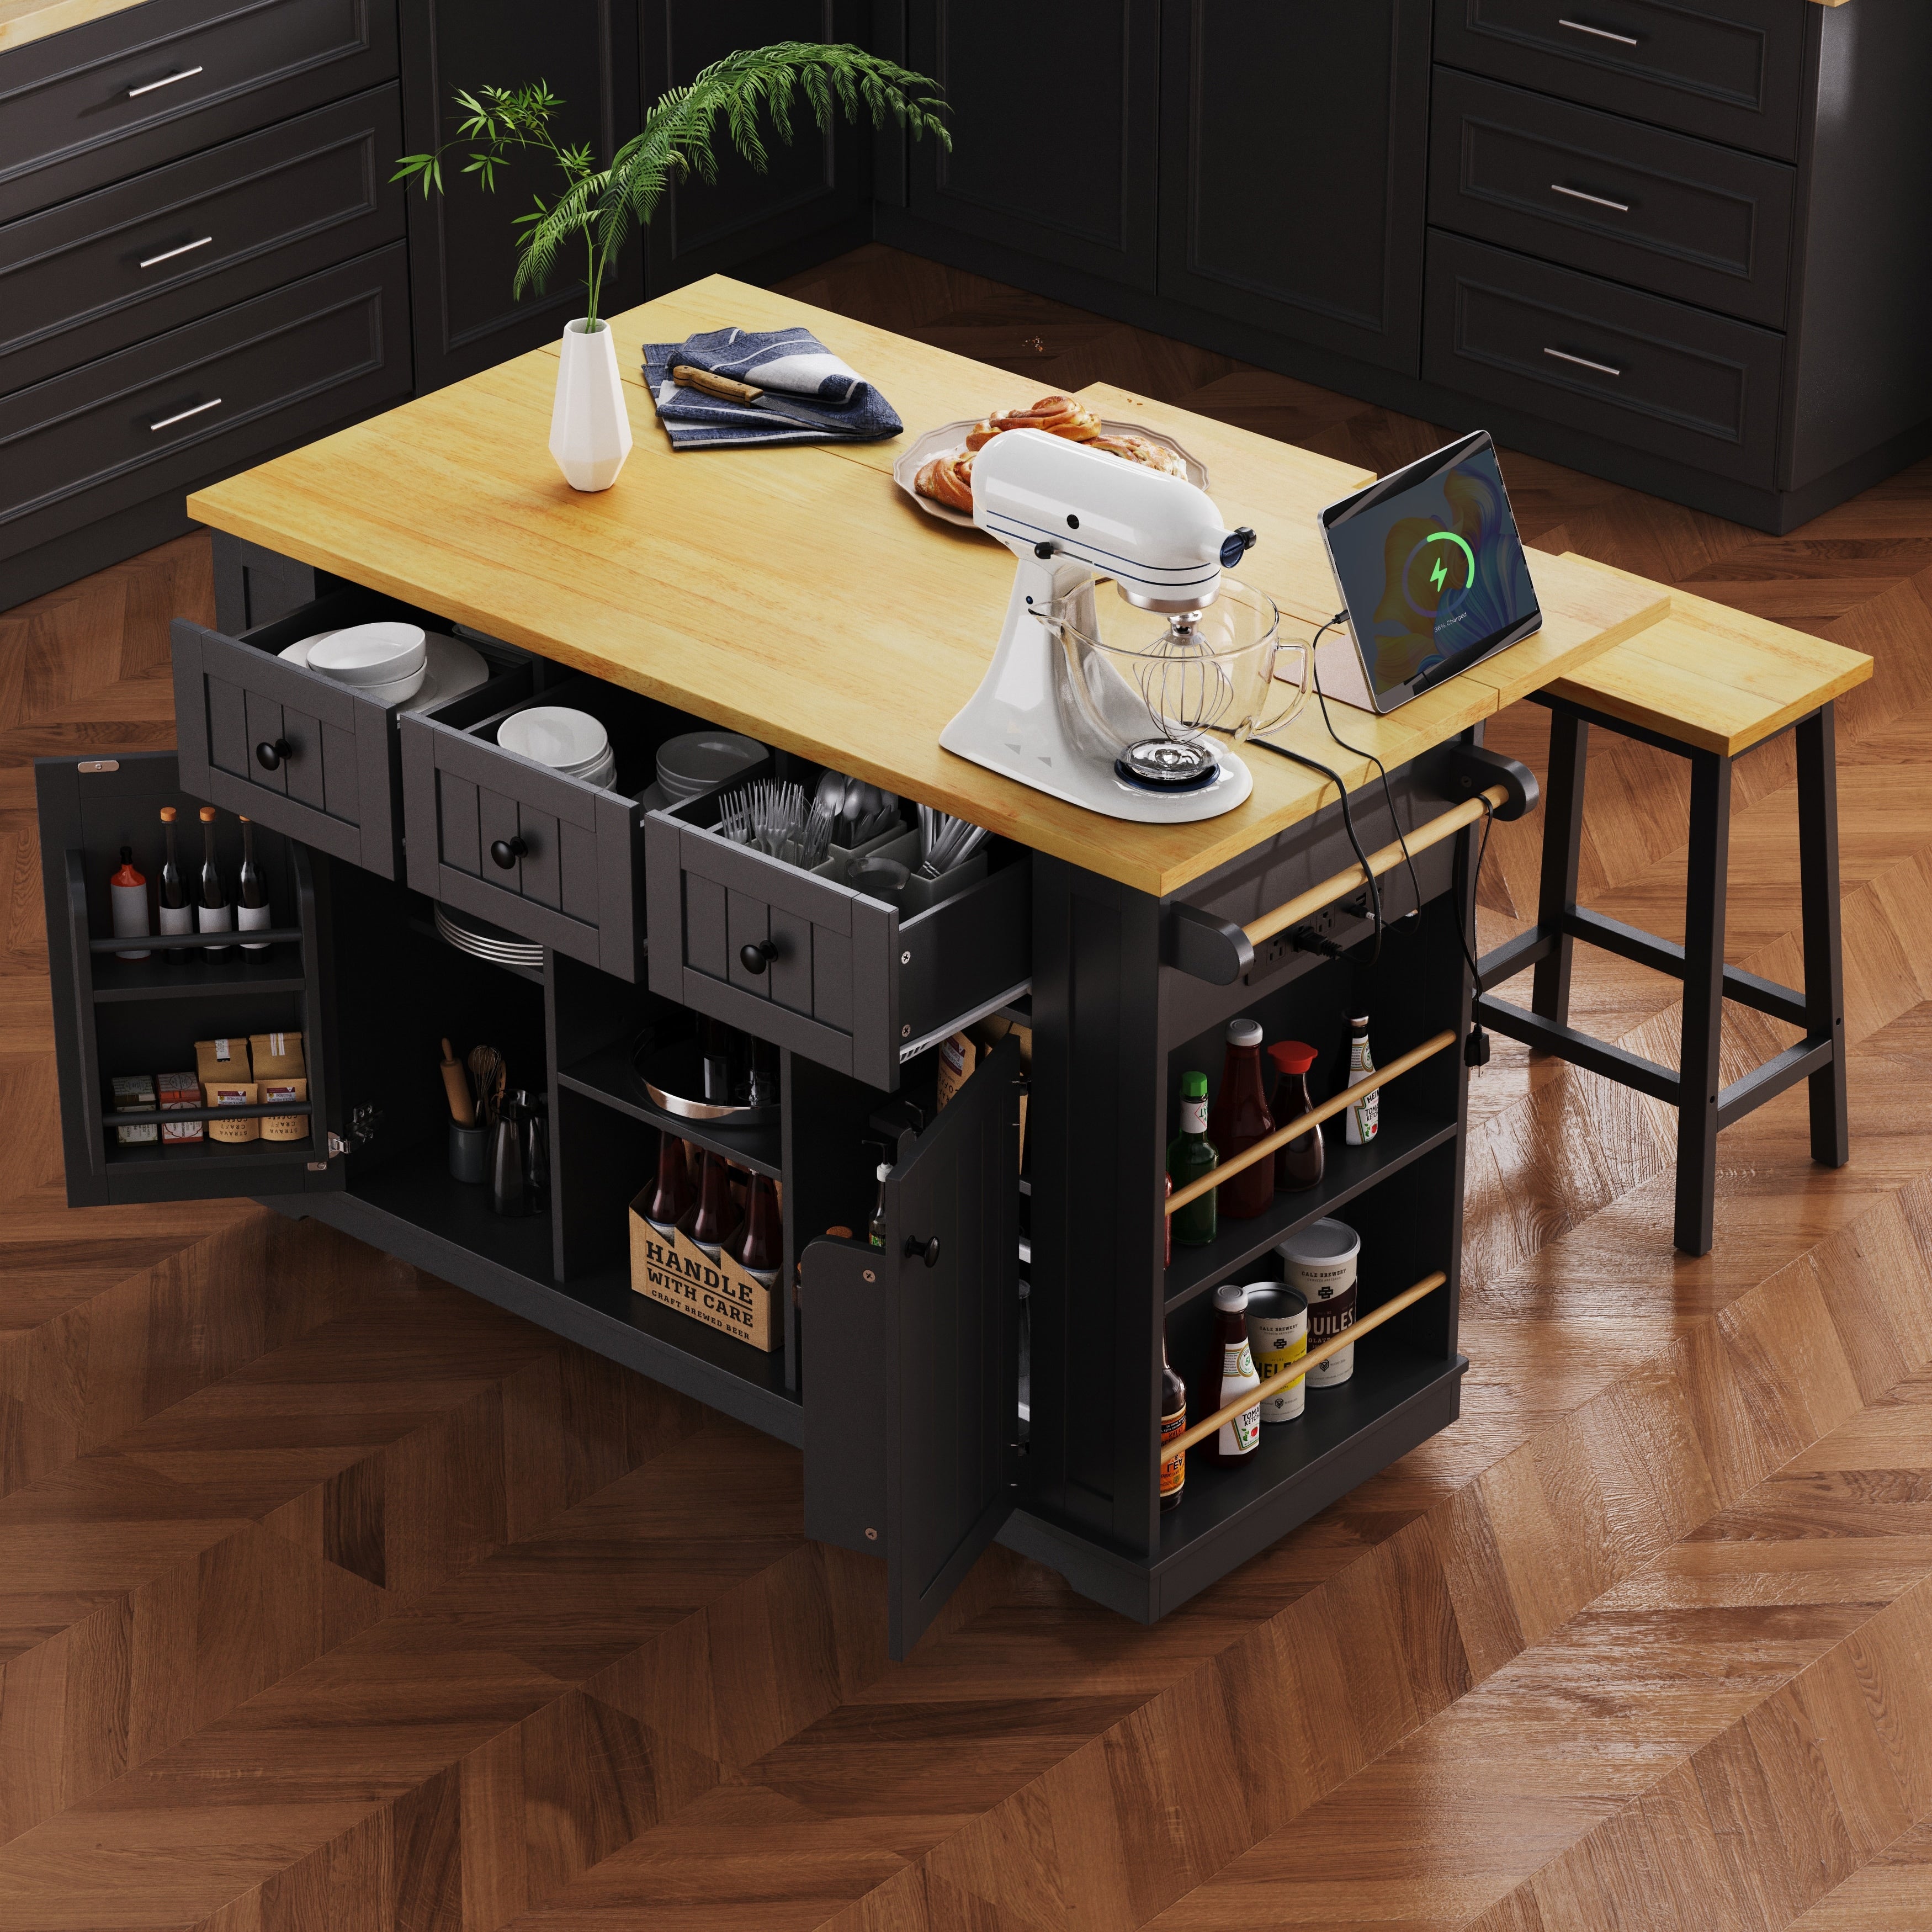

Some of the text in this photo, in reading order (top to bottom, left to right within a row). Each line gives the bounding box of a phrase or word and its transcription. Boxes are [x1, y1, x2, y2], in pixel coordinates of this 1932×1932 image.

[1434, 612, 1467, 633] 36% Charged
[1367, 1090, 1379, 1103] HEIN
[1365, 1103, 1378, 1116] TOMA
[646, 1240, 753, 1305] HANDLE
[1320, 1268, 1346, 1277] BREWERY
[647, 1267, 753, 1328] WITH CARE
[652, 1290, 750, 1340] CRAFT BREWED BEER
[1242, 1406, 1259, 1421] TOMA
[1244, 1414, 1259, 1427] KETCH
